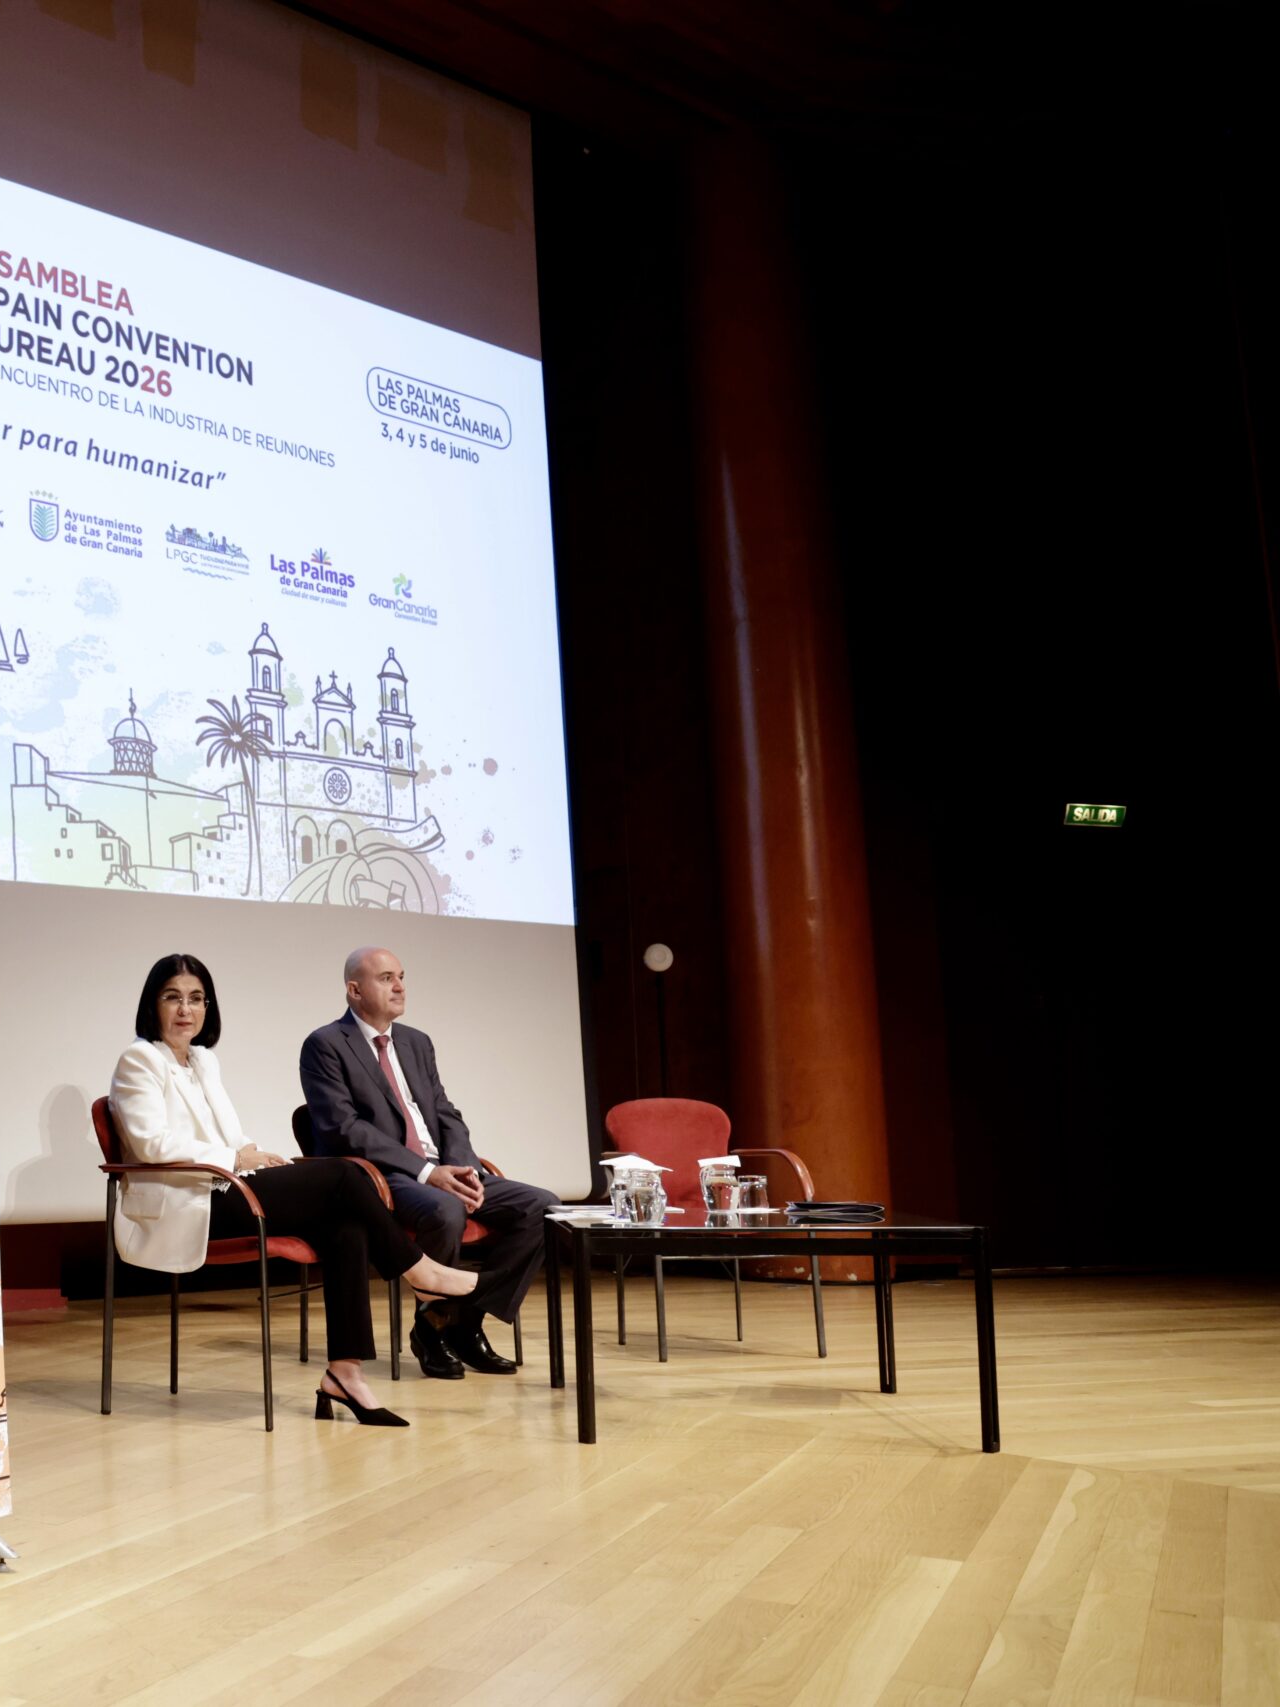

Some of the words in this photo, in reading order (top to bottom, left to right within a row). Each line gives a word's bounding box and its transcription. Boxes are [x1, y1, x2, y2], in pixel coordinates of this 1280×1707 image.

[72, 310, 253, 386] CONVENTION
[104, 355, 173, 397] 2026
[377, 374, 403, 396] LAS
[407, 384, 461, 413] PALMAS
[98, 391, 119, 410] DE
[124, 397, 144, 417] LA
[149, 404, 228, 440] INDUSTRIA
[232, 427, 252, 446] DE
[256, 432, 336, 468] REUNIONES
[378, 391, 397, 410] DE
[400, 399, 440, 423] GRAN
[443, 412, 503, 443] CANARIA
[19, 427, 78, 458] para
[380, 422, 392, 441] 3,
[396, 428, 404, 443] 4
[408, 433, 416, 448] y
[419, 433, 427, 449] 5
[431, 437, 447, 454] de
[449, 442, 480, 464] junio
[64, 509, 143, 535] Ayuntamiento
[64, 520, 77, 532] de
[84, 524, 100, 537] Las
[106, 529, 143, 546] Palmas
[64, 533, 77, 544] de
[79, 536, 103, 550] Gran
[106, 542, 143, 558] Canaria
[166, 547, 198, 564] LPGC
[270, 553, 296, 575] Las
[301, 560, 355, 588] Palmas
[279, 574, 291, 586] de
[293, 578, 314, 591] Gran
[316, 582, 348, 598] Canaria
[368, 593, 437, 619] GranCanaria
[1073, 806, 1117, 823] SALIDA
